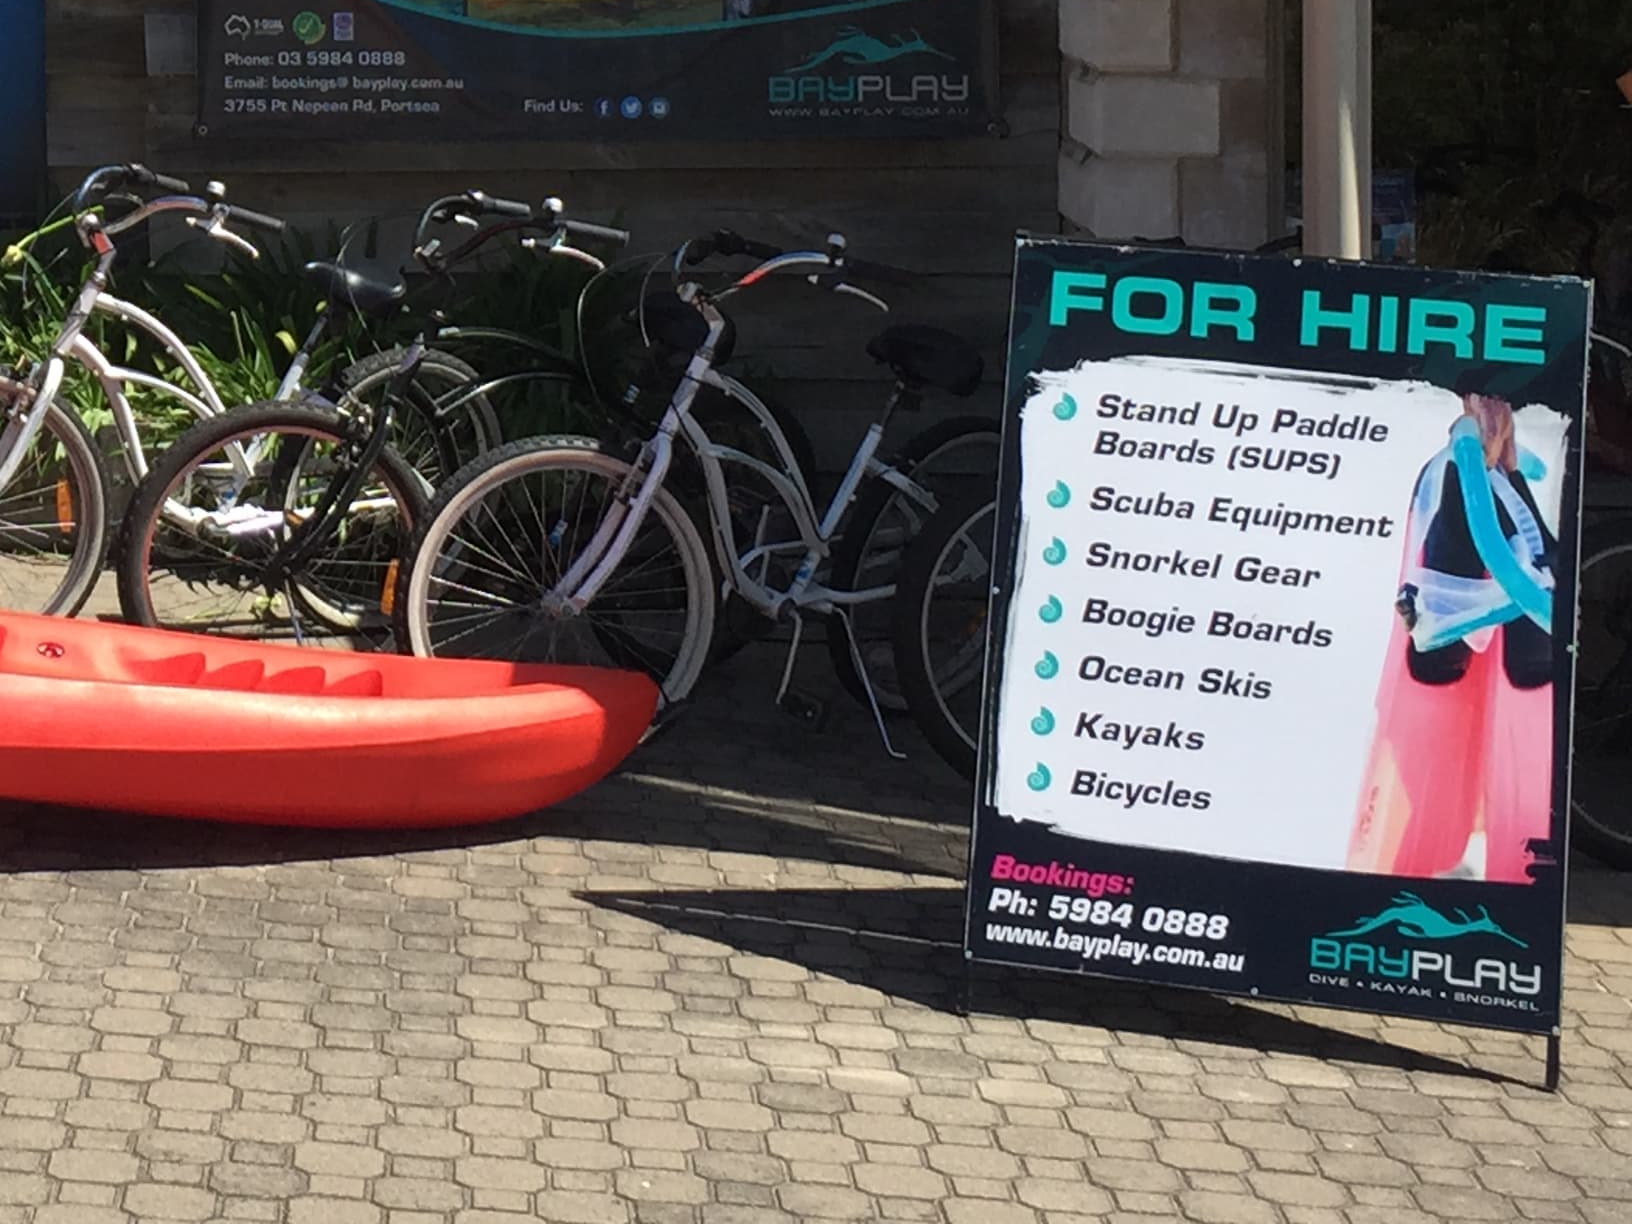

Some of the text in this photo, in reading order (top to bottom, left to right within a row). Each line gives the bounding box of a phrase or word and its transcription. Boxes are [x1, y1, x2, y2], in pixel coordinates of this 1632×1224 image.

[223, 51, 406, 67] Phone: 03 5984 0888
[223, 75, 269, 90] Email:
[767, 74, 969, 103] BAYPLAY
[223, 98, 441, 115] 3755 Pt Nepean Rd, Portsea
[523, 99, 584, 113] Find Us:
[1049, 270, 1547, 365] FOR HIRE
[1095, 392, 1390, 444] Stand Up Paddle
[1093, 432, 1342, 480] Boards (SUPS)
[1089, 485, 1394, 540] Scuba Equipment
[1085, 541, 1322, 590] Snorkel Gear
[1081, 598, 1334, 649] Boogie Boards
[1077, 655, 1273, 701] Ocean Skis
[1073, 711, 1206, 752] Kayaks
[1070, 769, 1213, 811] Bicycles
[990, 854, 1135, 897] Bookings:
[987, 887, 1230, 941] Ph: 5984 0888
[985, 921, 1245, 973] www.bayplay.com.au
[1309, 937, 1543, 995] BAYPLAY
[1309, 973, 1541, 1012] DIVE KAYAK SNORKEL
